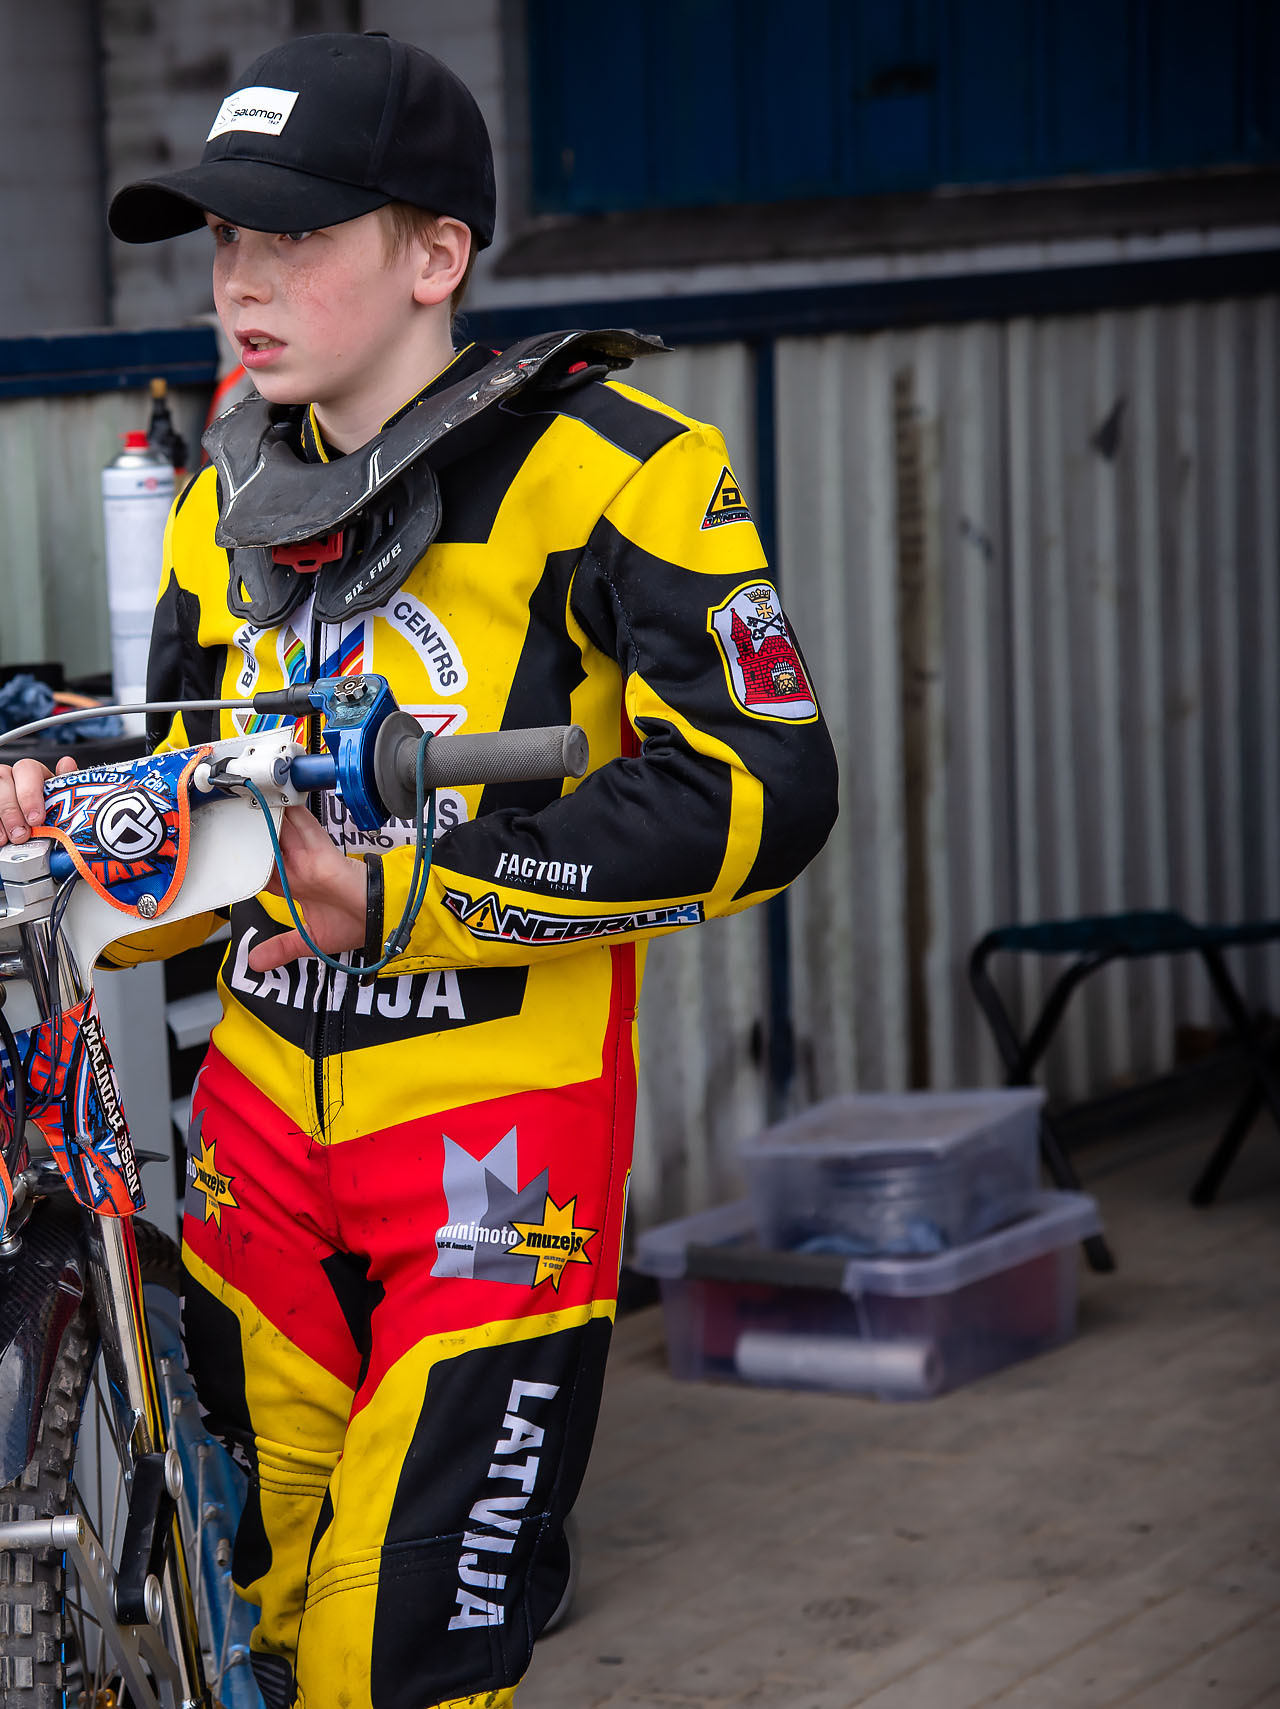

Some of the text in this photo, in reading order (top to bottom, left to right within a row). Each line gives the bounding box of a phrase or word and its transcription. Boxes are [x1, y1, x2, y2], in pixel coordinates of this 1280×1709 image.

[393, 601, 459, 687] CENTRS
[494, 852, 593, 893] FACTORY
[82, 1019, 124, 1132] MALINIAK
[526, 1231, 584, 1256] muzejs
[448, 1379, 559, 1631] LATVIJA
